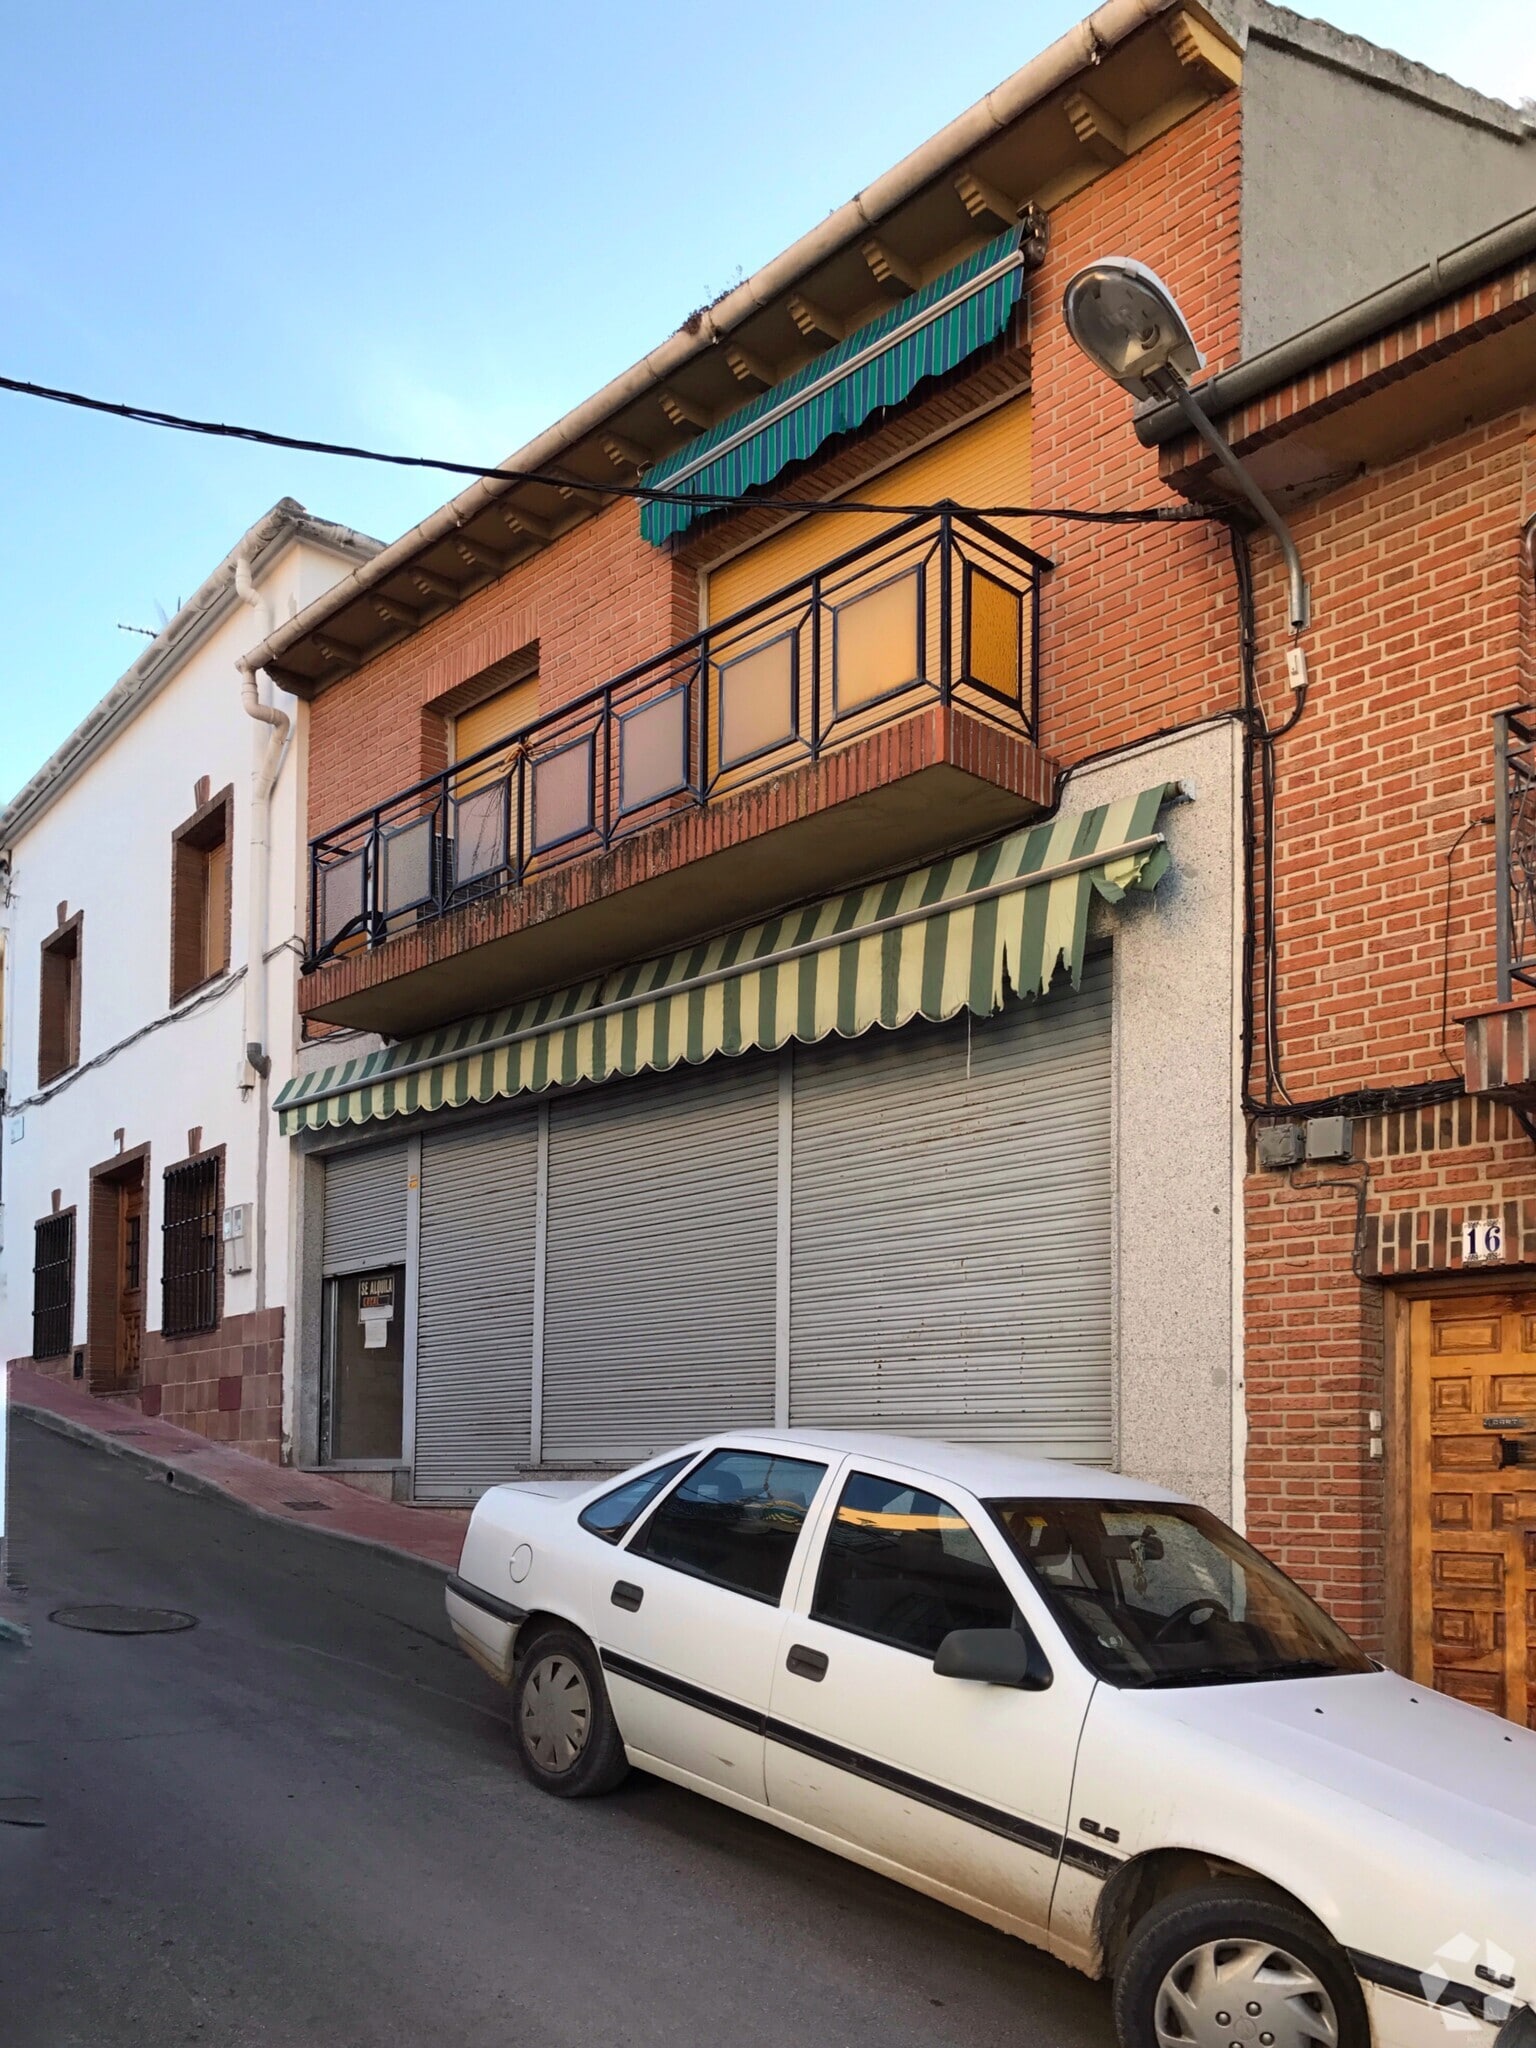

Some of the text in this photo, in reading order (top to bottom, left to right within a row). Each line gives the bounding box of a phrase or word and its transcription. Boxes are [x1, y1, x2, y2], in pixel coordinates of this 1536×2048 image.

[1467, 1225, 1501, 1254] 16
[361, 1278, 393, 1296] SE ALQUILA
